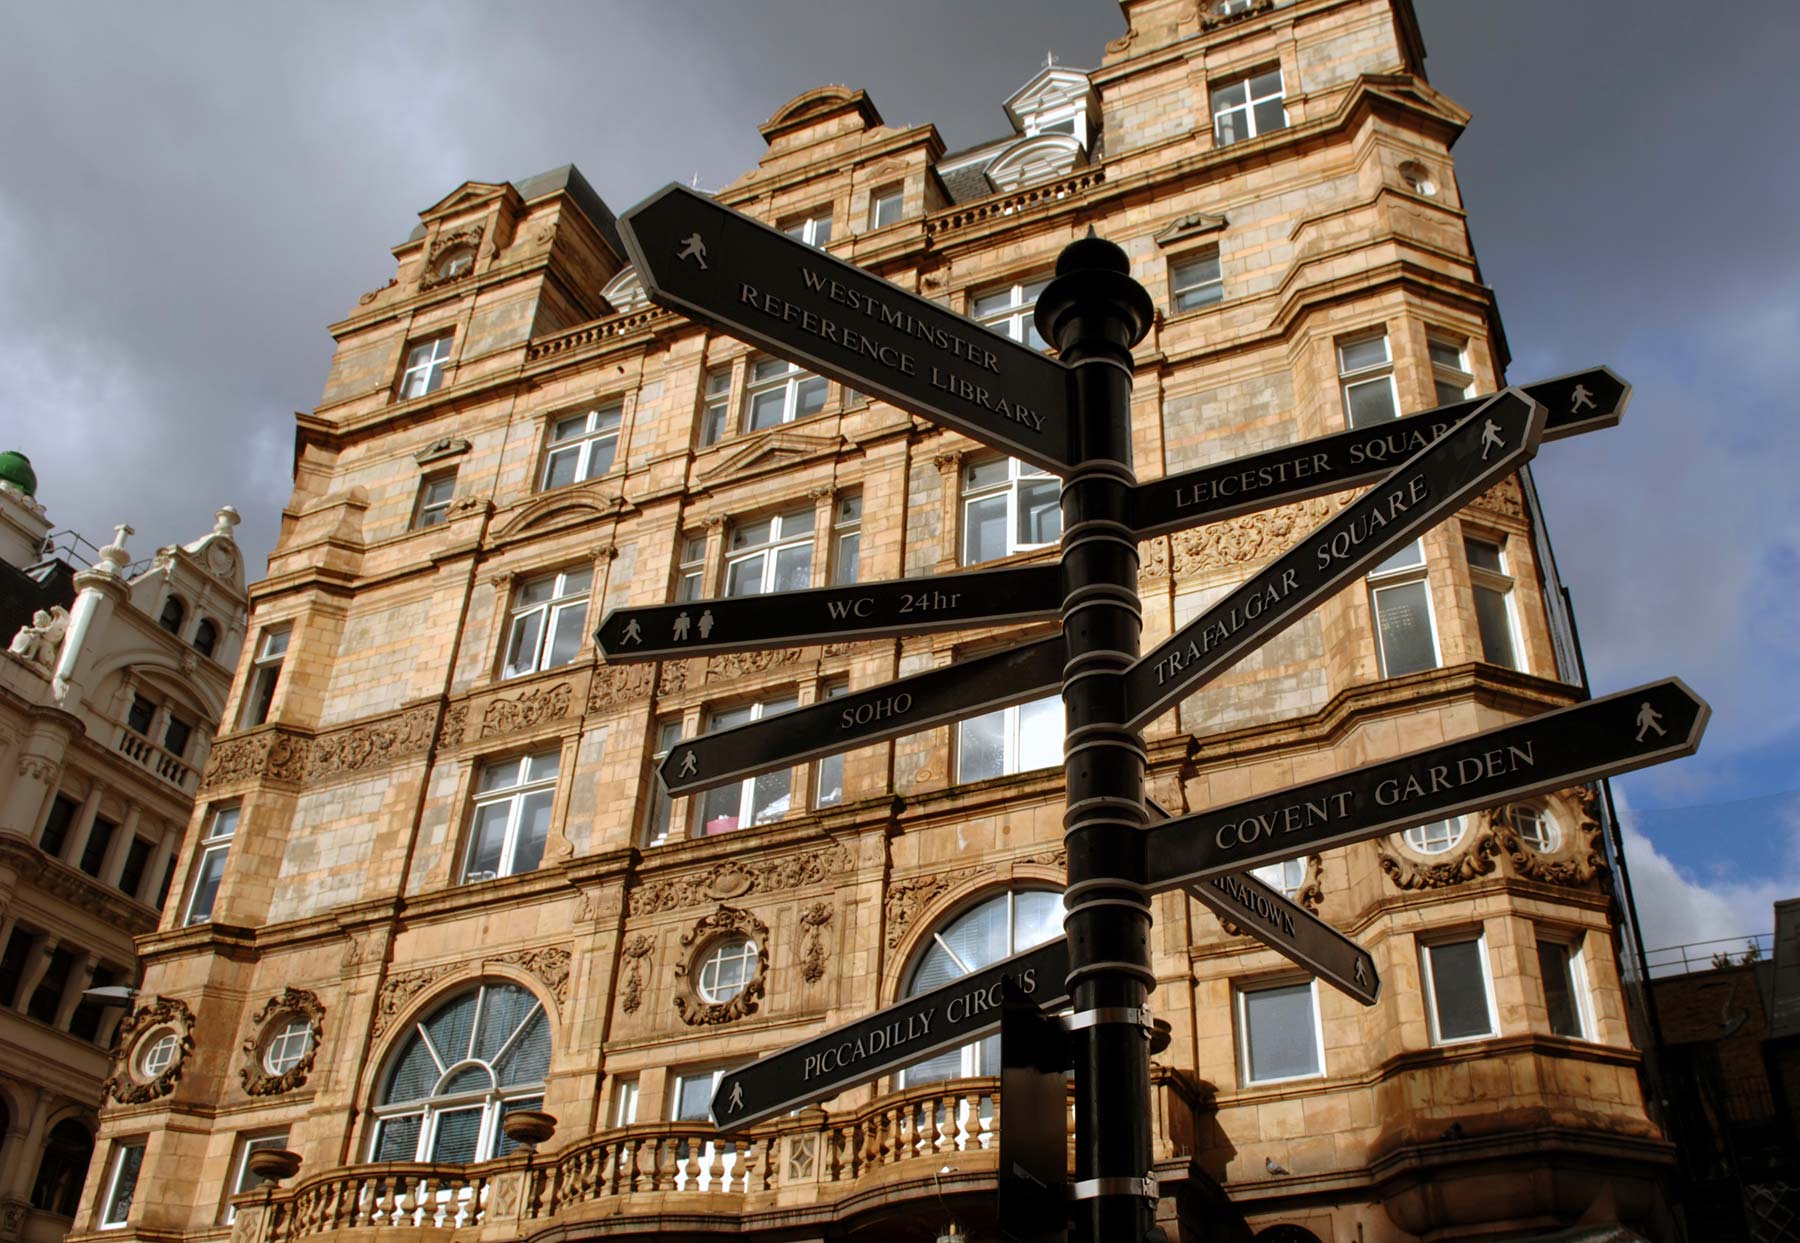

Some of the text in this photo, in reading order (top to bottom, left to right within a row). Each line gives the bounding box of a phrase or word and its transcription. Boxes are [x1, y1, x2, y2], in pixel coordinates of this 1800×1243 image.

[739, 283, 1047, 433] REFERENCE LIBRARY
[802, 267, 1001, 374] WESTMINSTER
[1175, 419, 1463, 508] LEICESTER SQUAR
[827, 591, 960, 620] WC 24hr
[1153, 473, 1429, 687] TRAFALGAR SQUARE
[841, 693, 912, 729] SOHO
[1215, 741, 1536, 850] COVENT GARDEN
[804, 1008, 935, 1080] PICCADILLY
